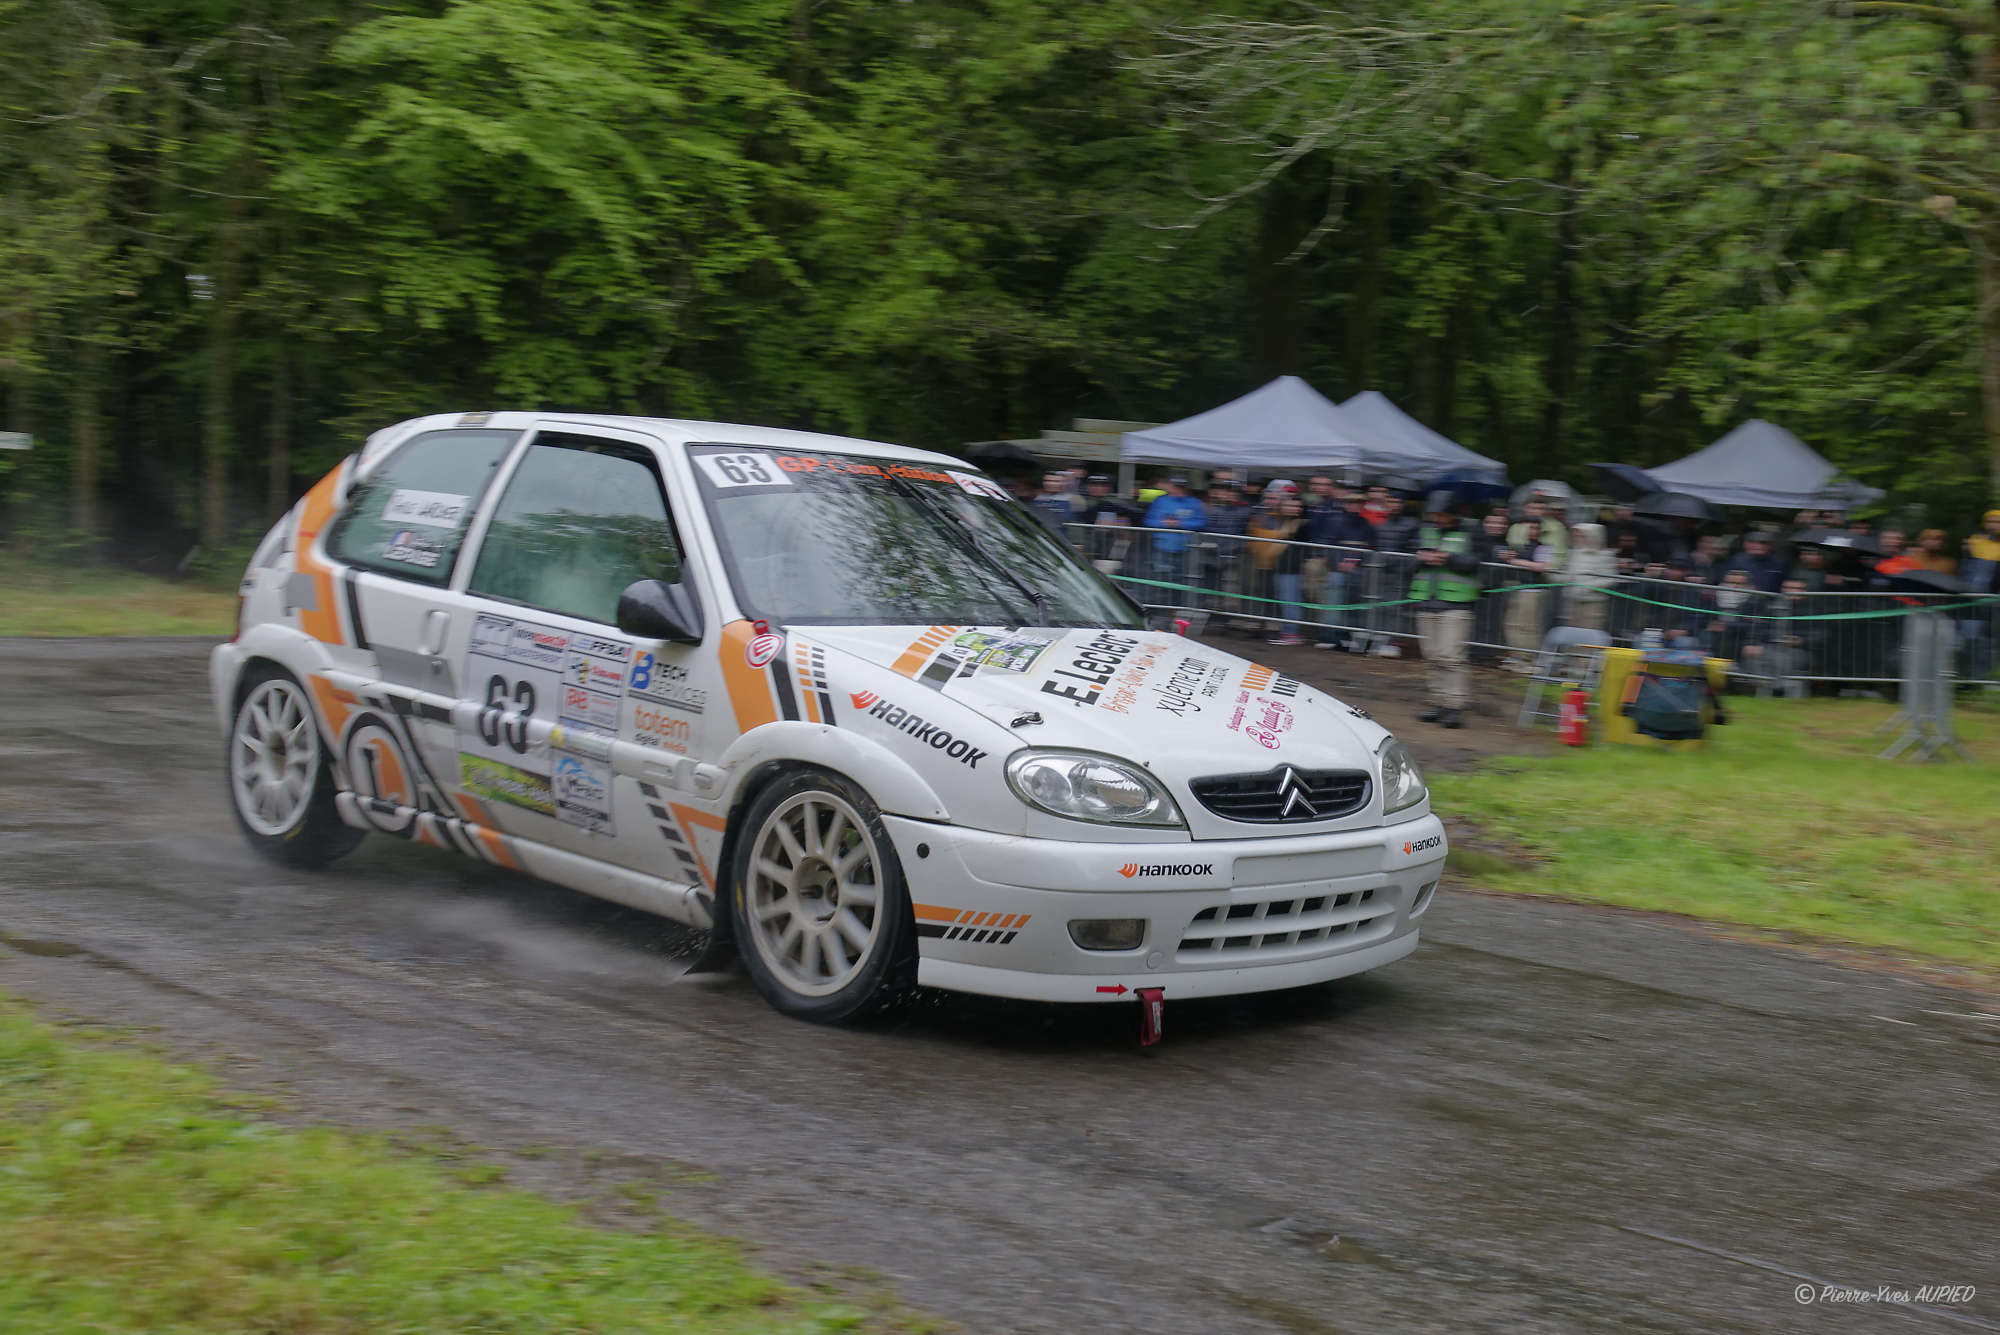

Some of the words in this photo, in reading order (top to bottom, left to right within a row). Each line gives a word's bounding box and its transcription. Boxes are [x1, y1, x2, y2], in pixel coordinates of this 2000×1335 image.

[713, 455, 770, 484] 63
[775, 456, 821, 472] GP
[630, 650, 655, 690] B
[654, 662, 690, 682] TECH
[1040, 633, 1139, 705] E.Leclerc
[478, 674, 536, 754] 63
[634, 704, 691, 741] totem
